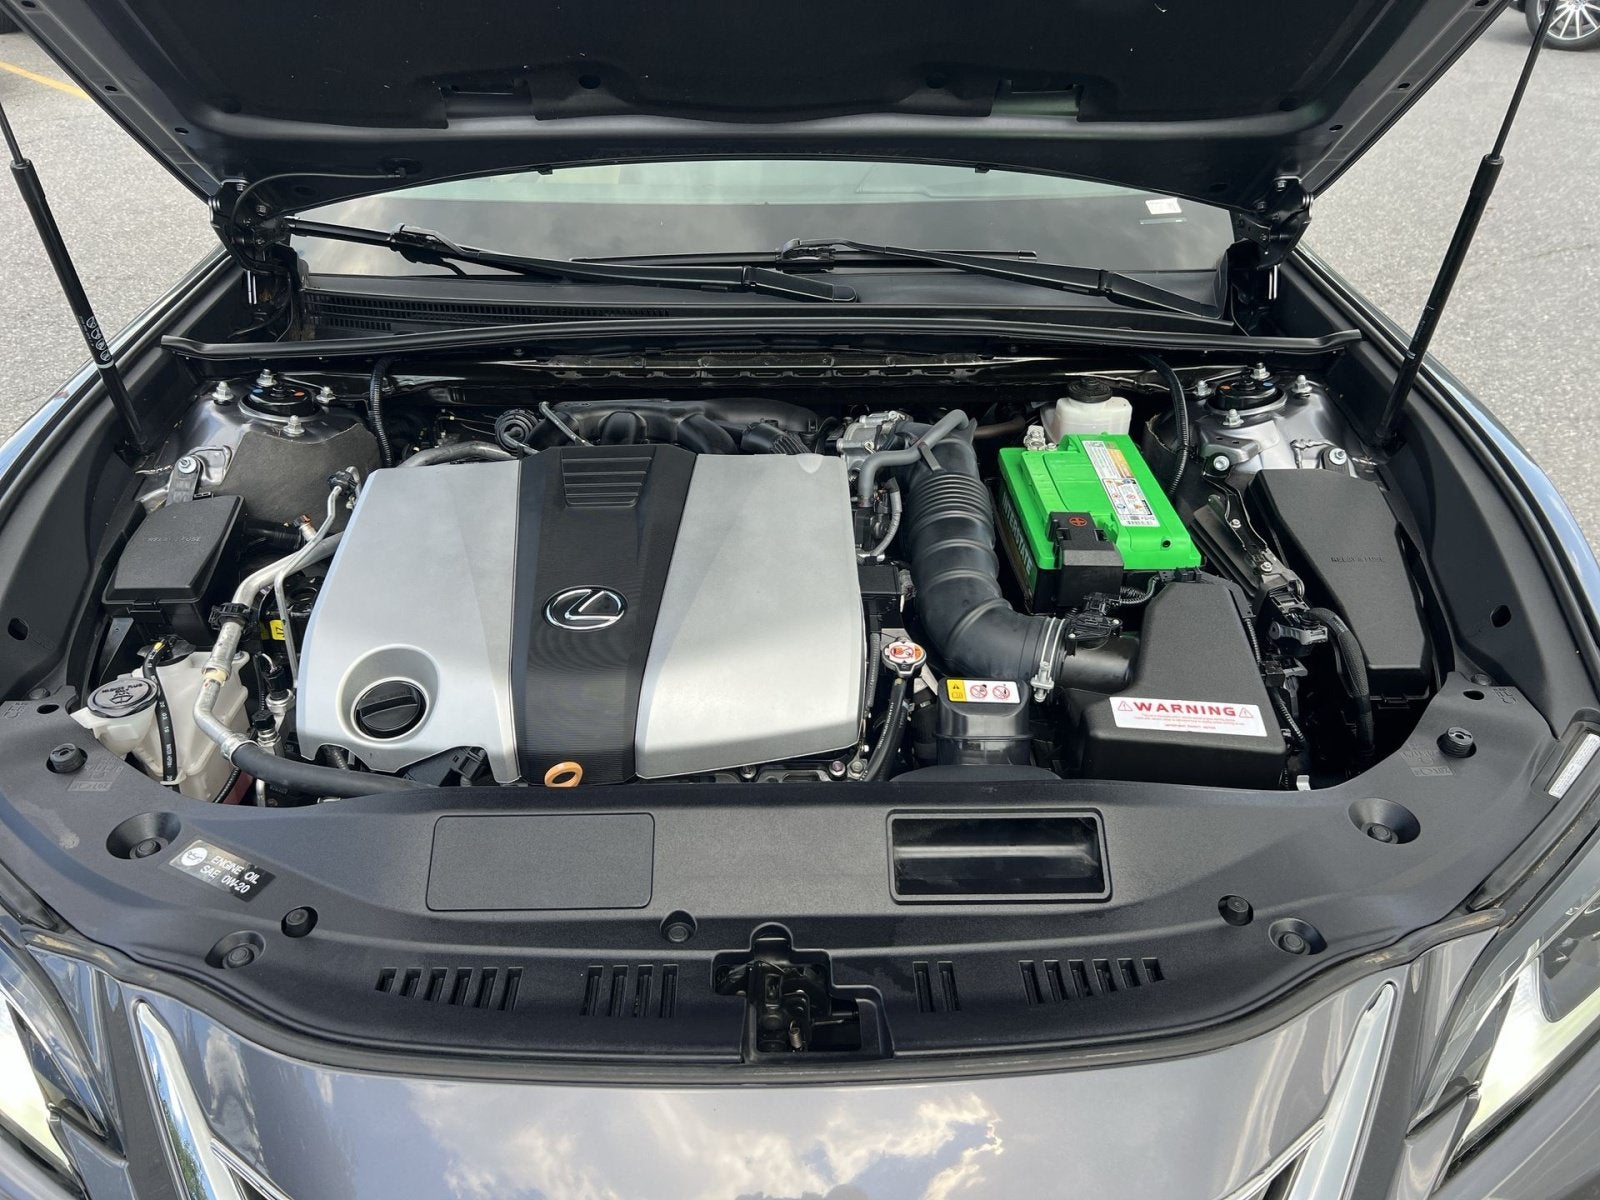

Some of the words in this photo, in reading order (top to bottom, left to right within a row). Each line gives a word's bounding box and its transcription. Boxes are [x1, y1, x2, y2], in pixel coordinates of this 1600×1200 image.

[1002, 491, 1033, 576] INTERSTATE
[1133, 702, 1237, 717] WARNING
[199, 864, 222, 879] SAE
[220, 875, 251, 894] 0W-20
[210, 855, 245, 876] ENGINE
[244, 871, 260, 885] OIL
